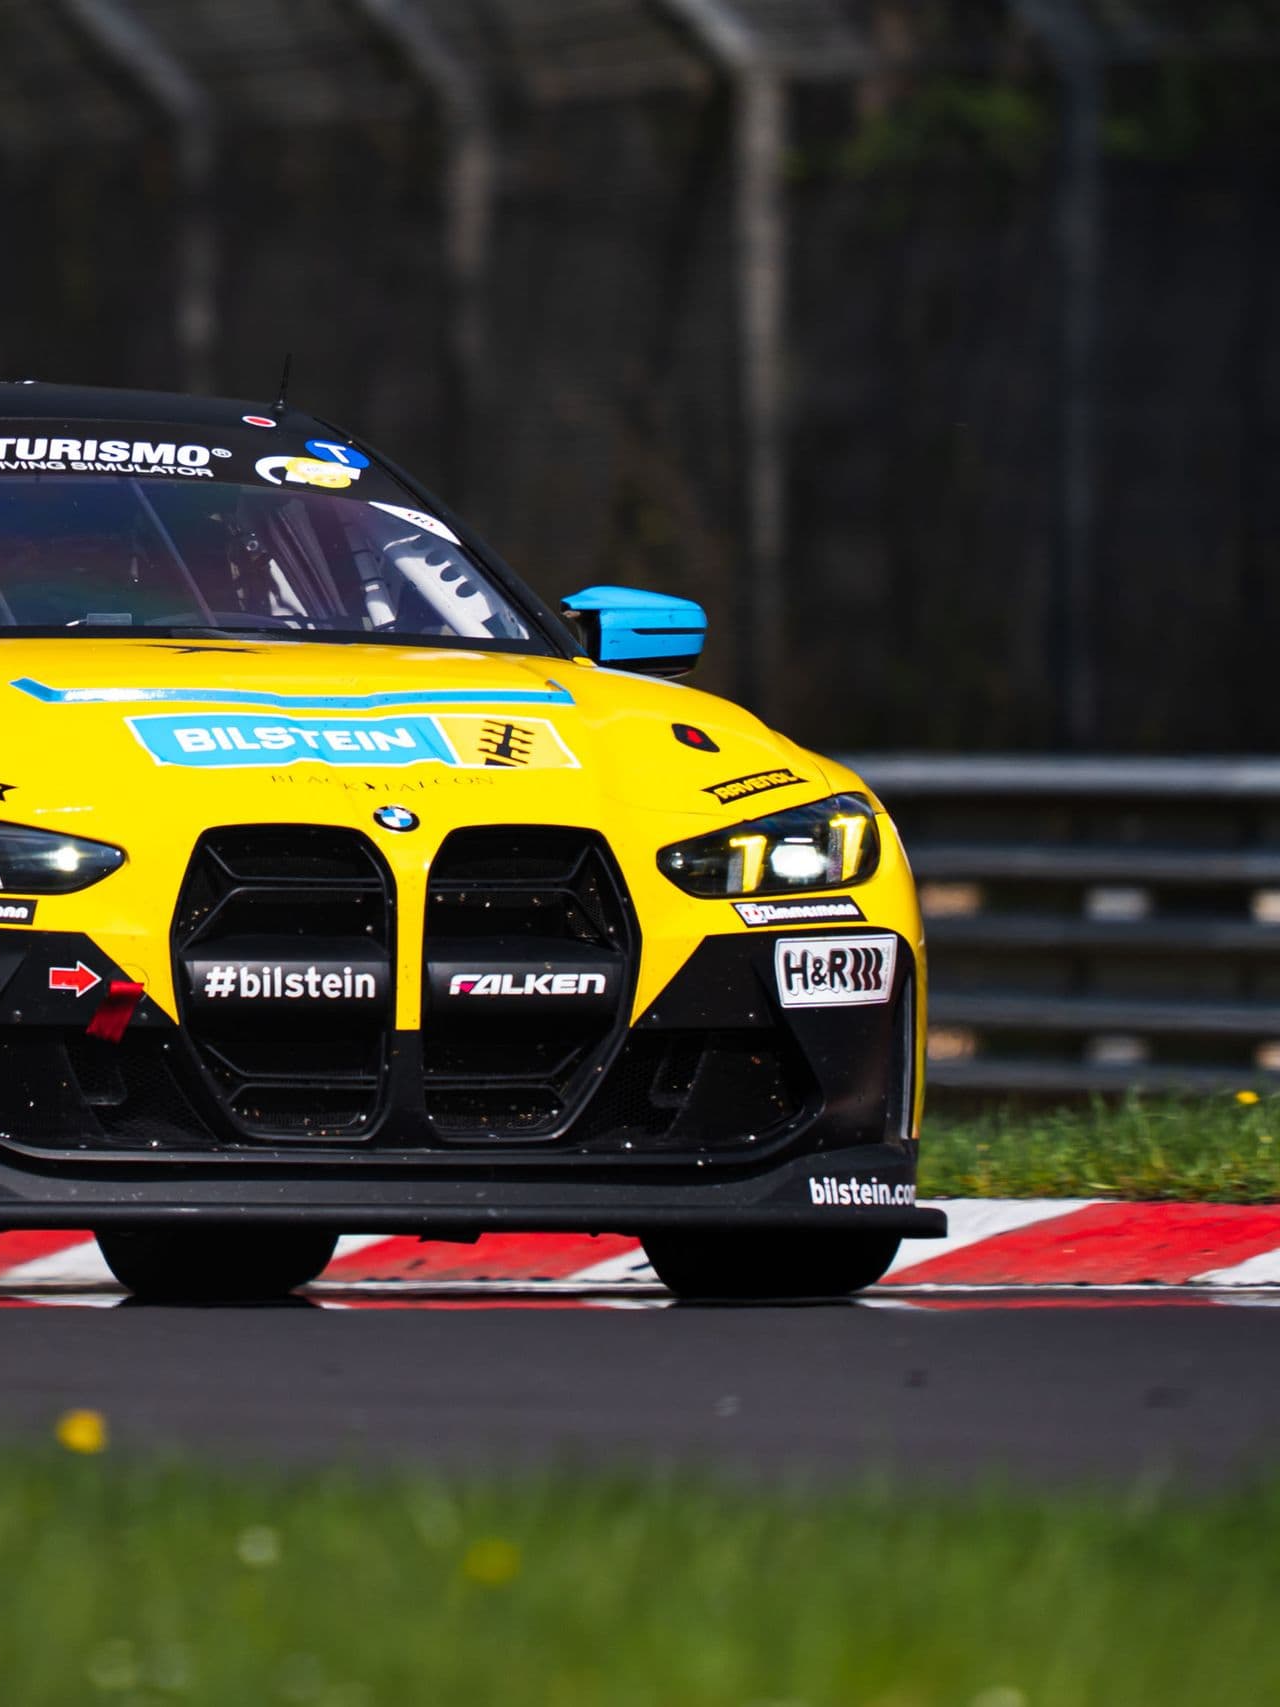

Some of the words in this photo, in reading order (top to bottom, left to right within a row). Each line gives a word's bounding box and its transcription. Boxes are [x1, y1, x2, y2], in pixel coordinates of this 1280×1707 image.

[71, 461, 214, 477] SIMULATOR
[174, 727, 417, 753] BILSTEIN
[713, 770, 798, 800] RAVENOL
[204, 966, 376, 998] #bilstein
[783, 948, 848, 991] H&R
[449, 973, 606, 995] FALKEN
